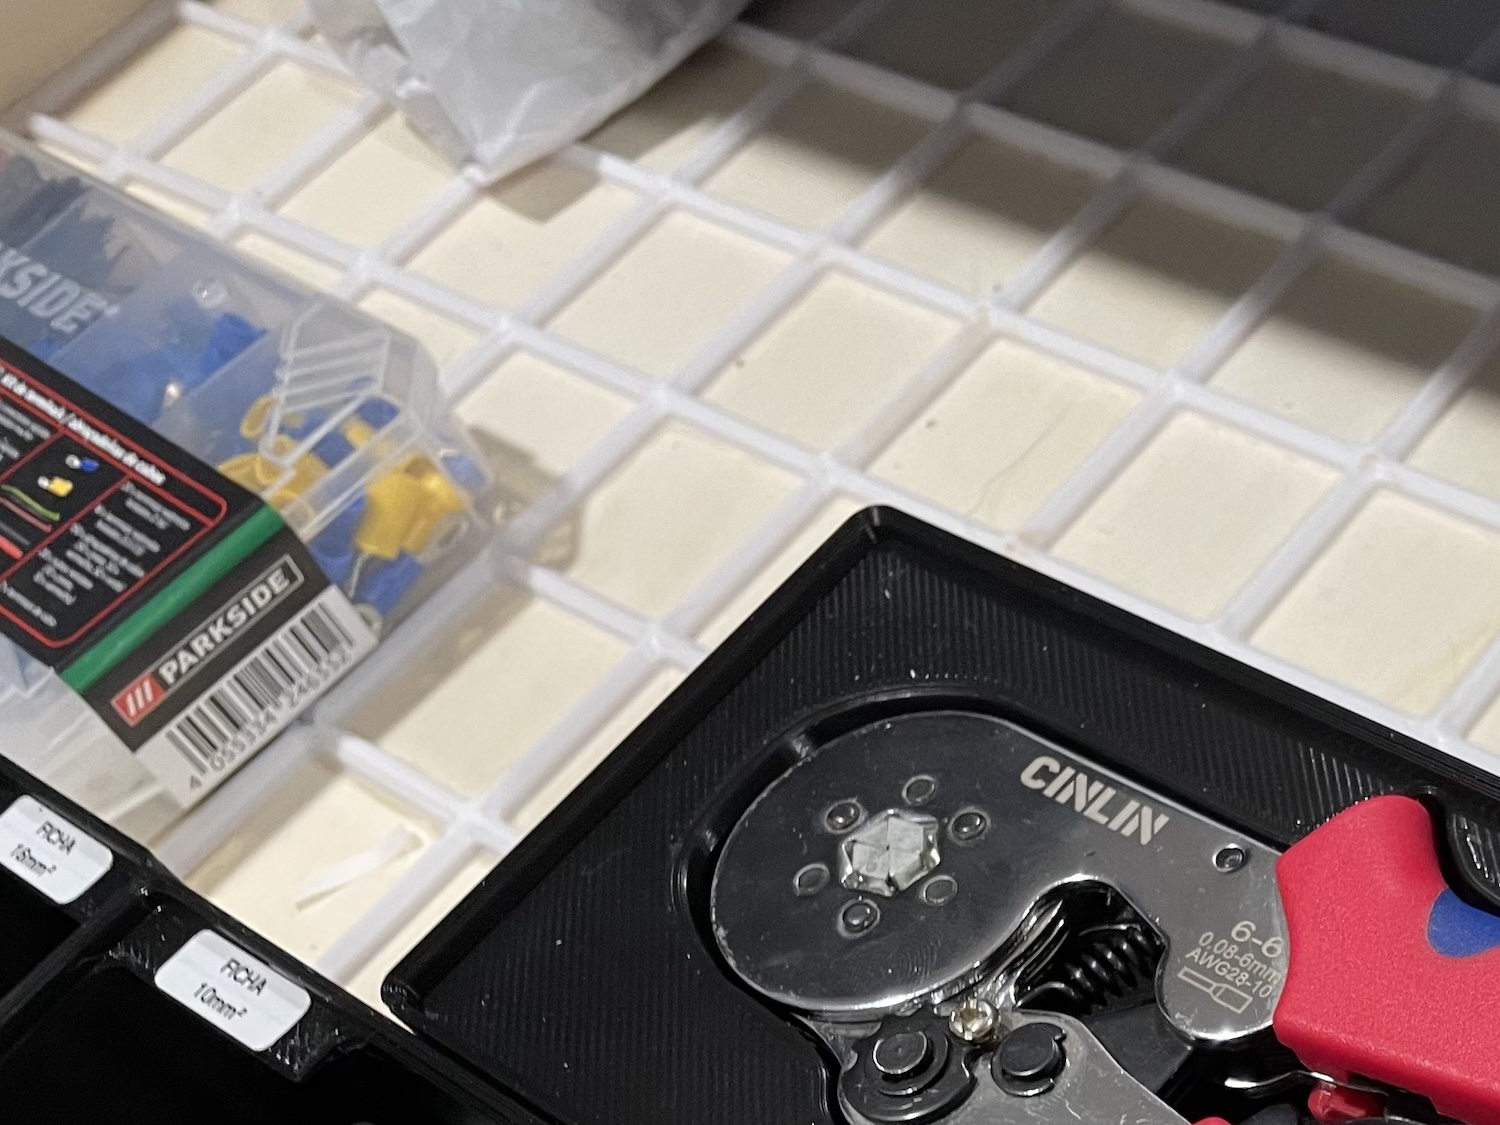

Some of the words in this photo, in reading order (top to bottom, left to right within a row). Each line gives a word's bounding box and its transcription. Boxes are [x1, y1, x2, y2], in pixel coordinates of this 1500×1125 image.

[158, 568, 290, 686] PARKSIDE
[1020, 754, 1170, 846] CINLIN
[1230, 920, 1284, 958] 6-6
[220, 956, 268, 997] FICHA
[1185, 947, 1273, 999] AWG28-10
